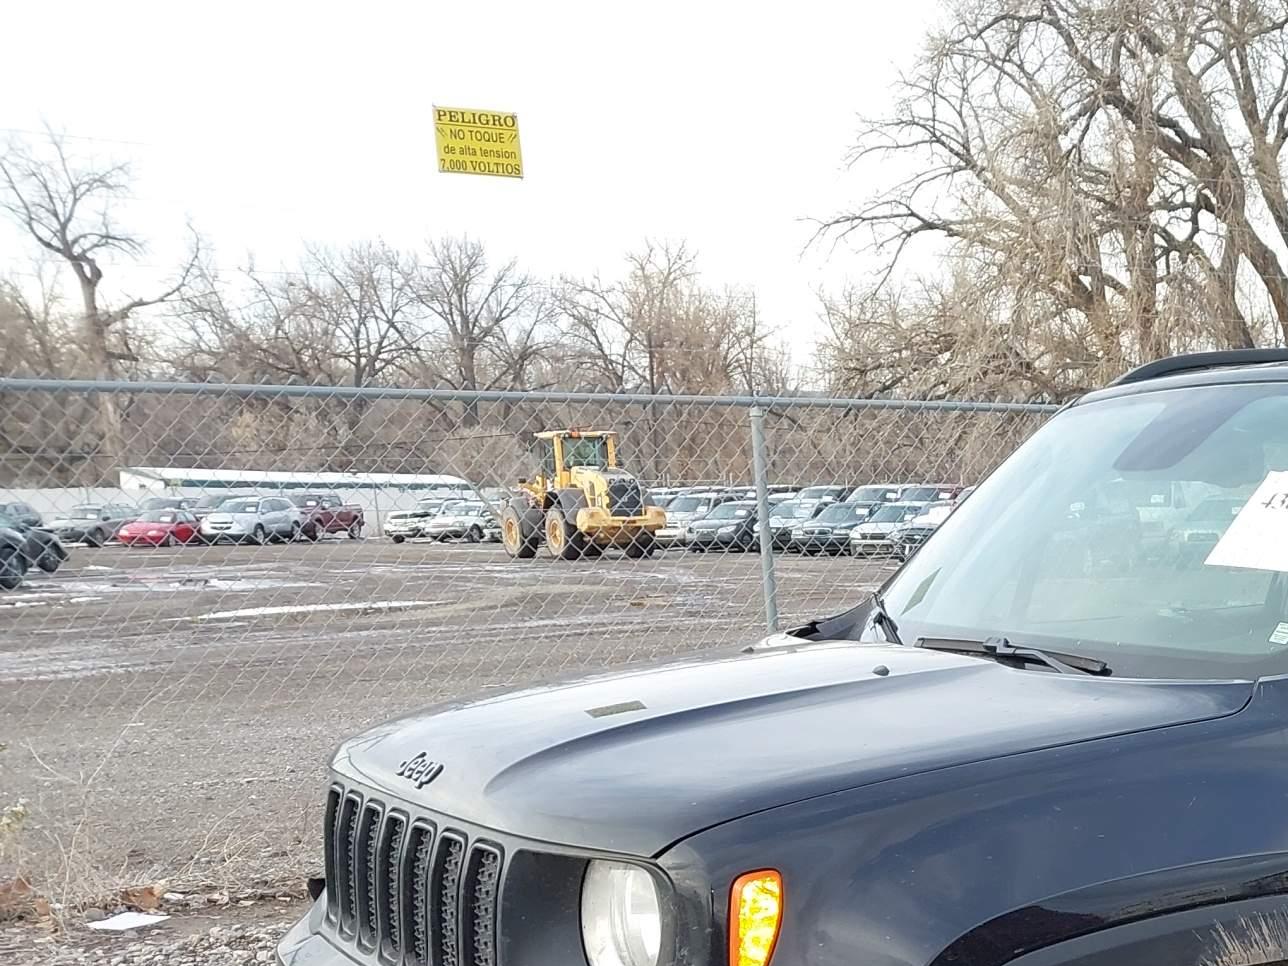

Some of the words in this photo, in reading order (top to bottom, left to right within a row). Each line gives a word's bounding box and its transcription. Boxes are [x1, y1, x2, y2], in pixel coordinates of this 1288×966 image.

[436, 109, 516, 128] PELIGRO
[449, 128, 465, 141] NO
[468, 130, 505, 143] TOQUE
[443, 144, 456, 155] de
[459, 145, 477, 156] alta
[480, 147, 517, 160] tension
[469, 160, 521, 175] VOLTIOS
[395, 751, 445, 790] Jeep
